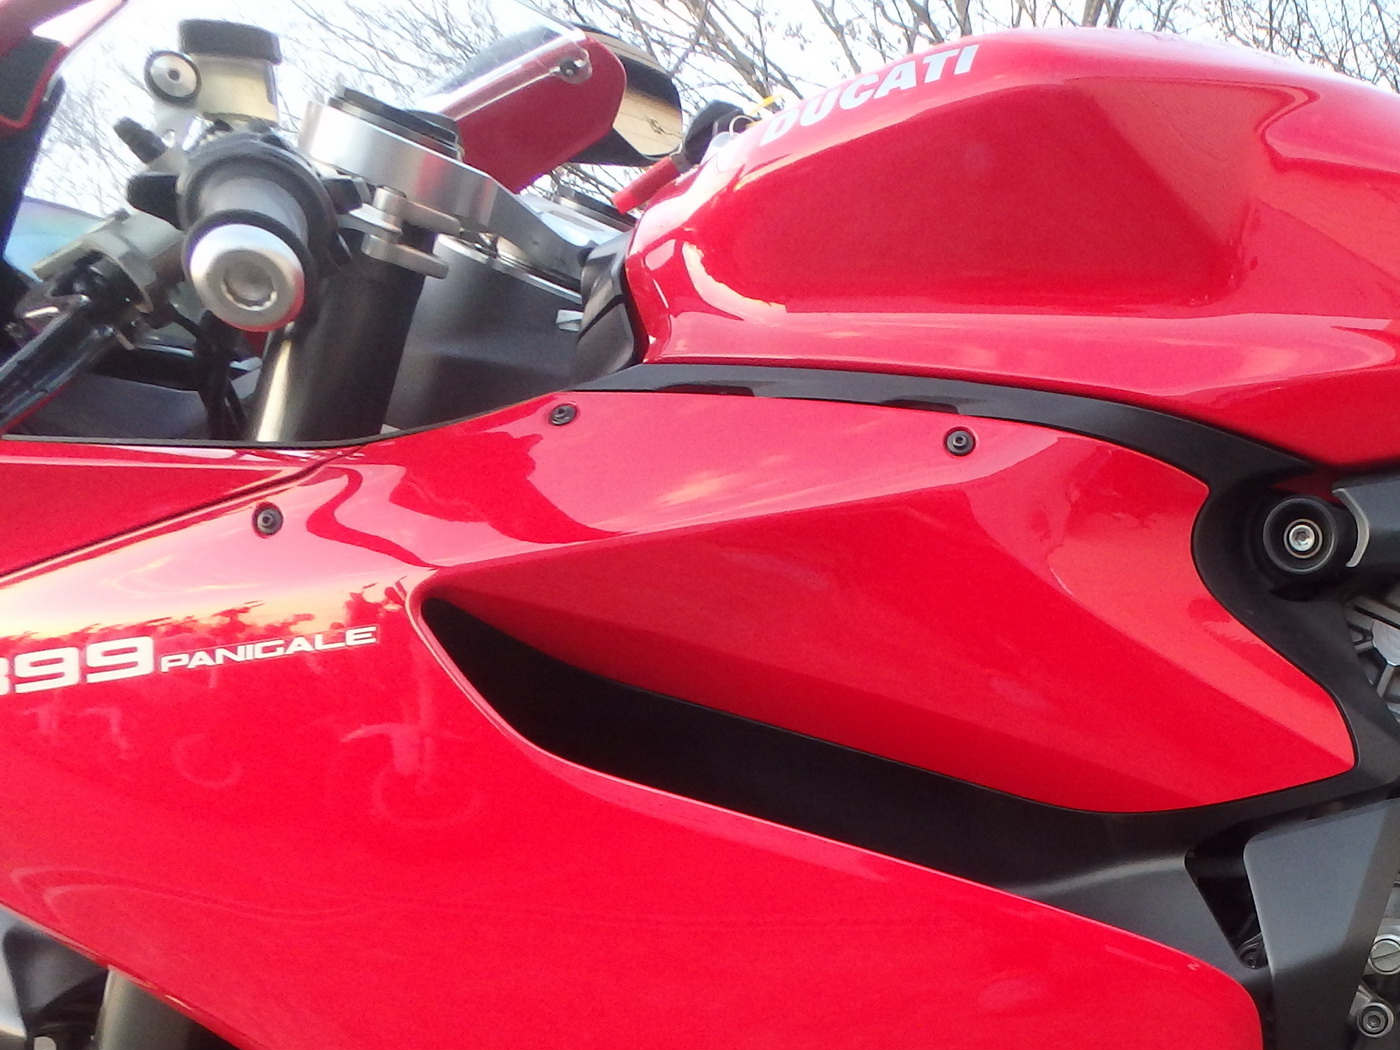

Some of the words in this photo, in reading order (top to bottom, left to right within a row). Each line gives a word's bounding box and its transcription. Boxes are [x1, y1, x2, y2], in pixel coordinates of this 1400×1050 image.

[758, 44, 979, 147] DUCATI
[0, 636, 154, 696] 99
[160, 626, 377, 672] PANIGALE
